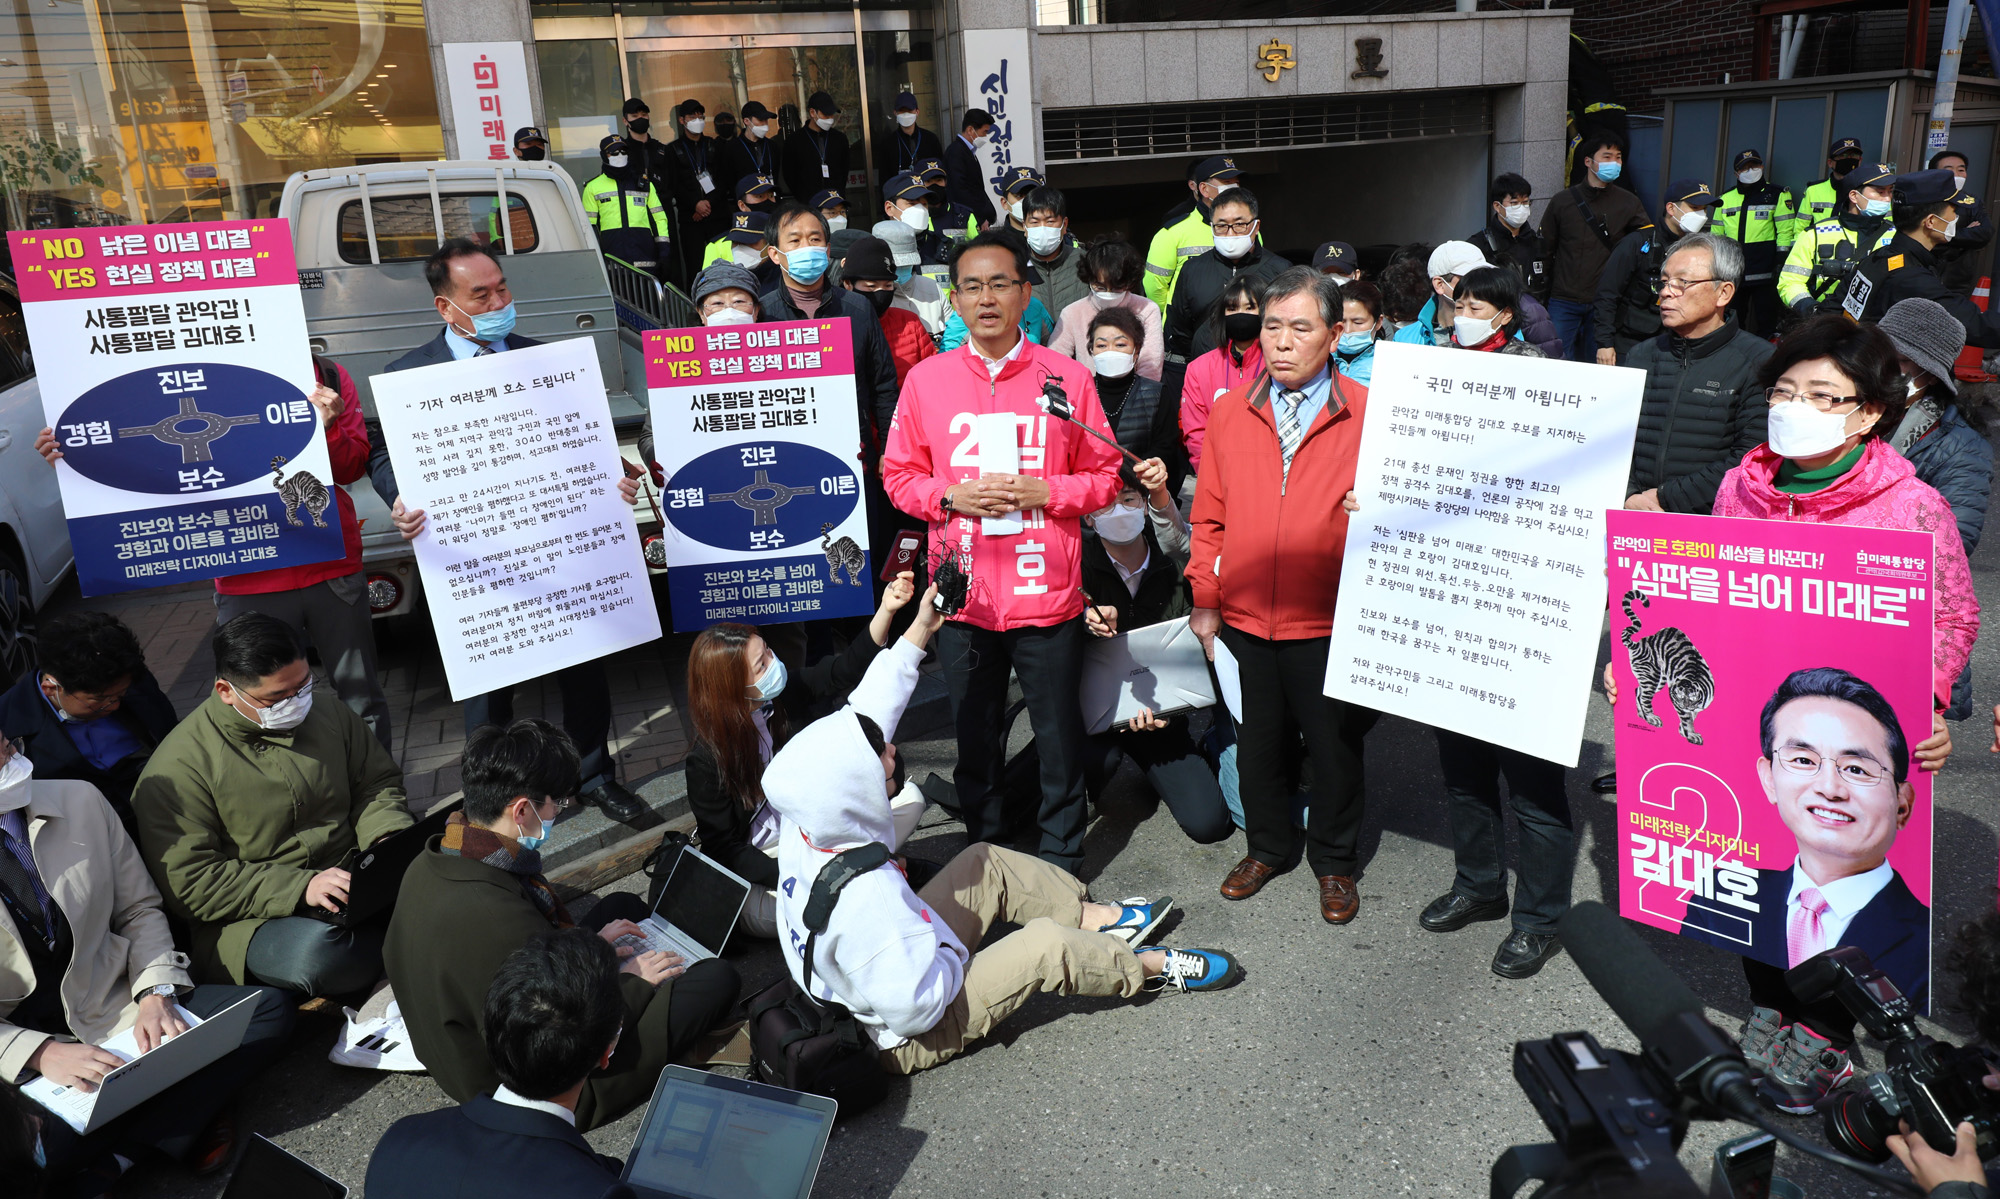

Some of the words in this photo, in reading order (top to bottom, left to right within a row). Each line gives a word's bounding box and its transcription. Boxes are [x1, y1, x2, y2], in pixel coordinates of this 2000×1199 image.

[99, 234, 147, 256] 낡은
[153, 231, 200, 252] 이념
[104, 263, 153, 285] 현실
[158, 260, 205, 282] 정책
[84, 303, 171, 328] 사통팔달
[175, 298, 238, 322] 관악갑
[90, 329, 175, 354] 사통팔달
[180, 324, 244, 348] 김대호
[706, 332, 740, 350] 낡은
[745, 329, 780, 347] 이념
[708, 356, 743, 375] 현실
[747, 353, 782, 372] 정책
[156, 368, 207, 394] 진보
[418, 396, 444, 411] 기자
[448, 385, 498, 405] 여러분께
[502, 380, 527, 395] 호소
[531, 369, 576, 389] 드립니다
[1425, 375, 1453, 394] 국민
[1460, 380, 1516, 401] 여러분께
[1523, 388, 1582, 409] 아룁니다
[690, 390, 754, 411] 사통팔달
[758, 386, 805, 406] 관악갑
[265, 400, 311, 424] 이론
[692, 412, 756, 432] 사통팔달
[759, 408, 808, 428] 김대호
[60, 420, 112, 446] 경험
[740, 446, 776, 466] 진보
[178, 466, 225, 491] 보수
[820, 475, 856, 495] 이론
[667, 487, 704, 508] 경험
[1014, 416, 1048, 595] 김호
[119, 516, 174, 538] 진보와
[178, 509, 230, 530] 보수를
[233, 504, 267, 523] 넘어
[114, 537, 169, 559] 경험과
[172, 530, 225, 550] 이론을
[228, 522, 279, 543] 겸비한
[749, 528, 785, 549] 보수
[125, 559, 179, 577] 미래전략
[182, 550, 236, 569] 디자이너
[238, 545, 278, 562] 김대호
[1612, 535, 1650, 552] 관악의
[1652, 538, 1668, 554] 큰
[1670, 539, 1714, 559] 호랑이
[1718, 544, 1765, 564] 세상을
[1768, 548, 1824, 569] 바꾼다!
[1868, 554, 1925, 570] 미래통합당
[704, 570, 744, 585] 진보와
[747, 566, 786, 582] 보수를
[789, 563, 815, 578] 넘어
[699, 587, 738, 602] 경험과
[742, 583, 781, 598] 이론을
[784, 579, 823, 595] 겸비한
[1728, 570, 1792, 611] 넘어
[706, 606, 745, 618] 미래전략
[748, 601, 788, 614] 디자이너
[790, 599, 820, 612] 김대호
[1630, 811, 1690, 841] 미래전략
[1694, 828, 1759, 861] 디자이너
[1630, 833, 1759, 912] 김대호
